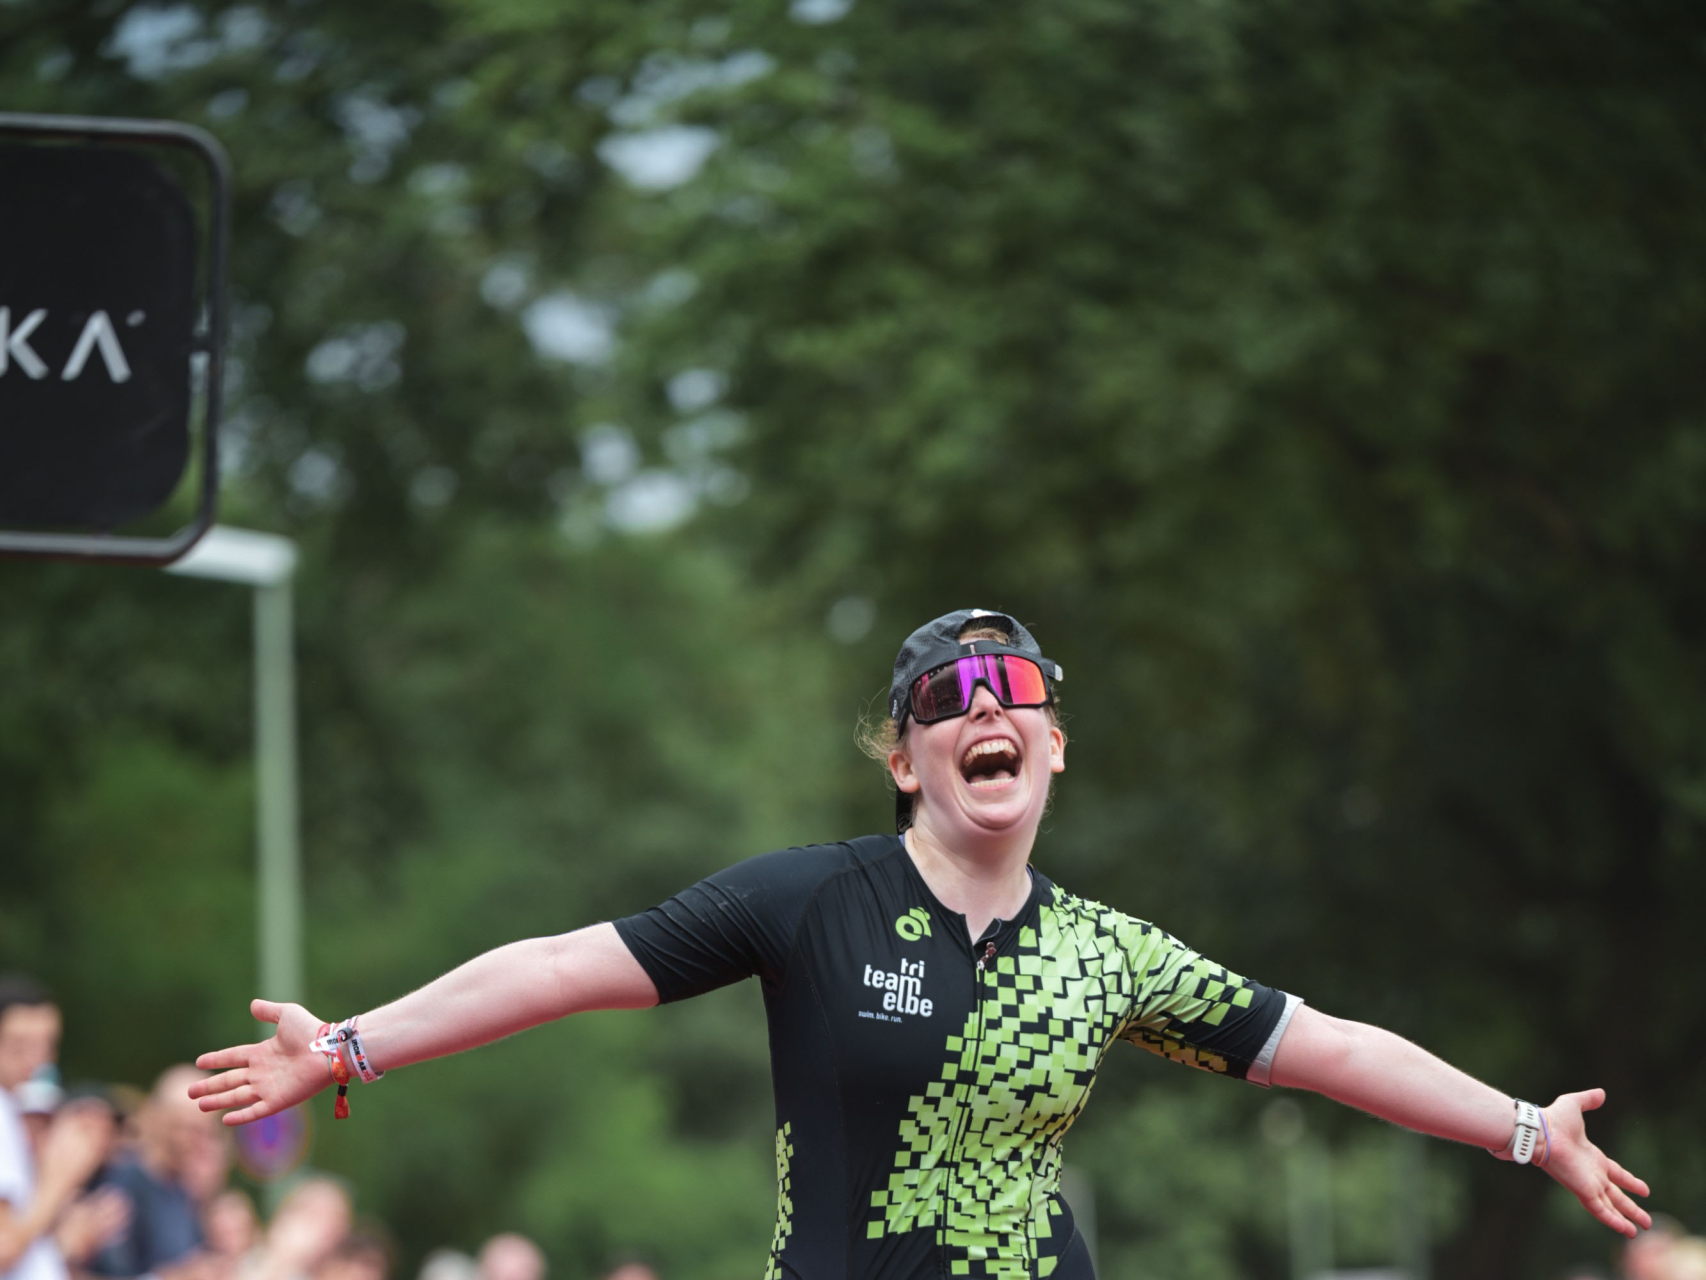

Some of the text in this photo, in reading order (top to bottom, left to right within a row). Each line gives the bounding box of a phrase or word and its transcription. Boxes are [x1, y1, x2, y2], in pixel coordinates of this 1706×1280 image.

[863, 964, 922, 995] team
[900, 958, 925, 978] tri
[883, 983, 933, 1017] elbe
